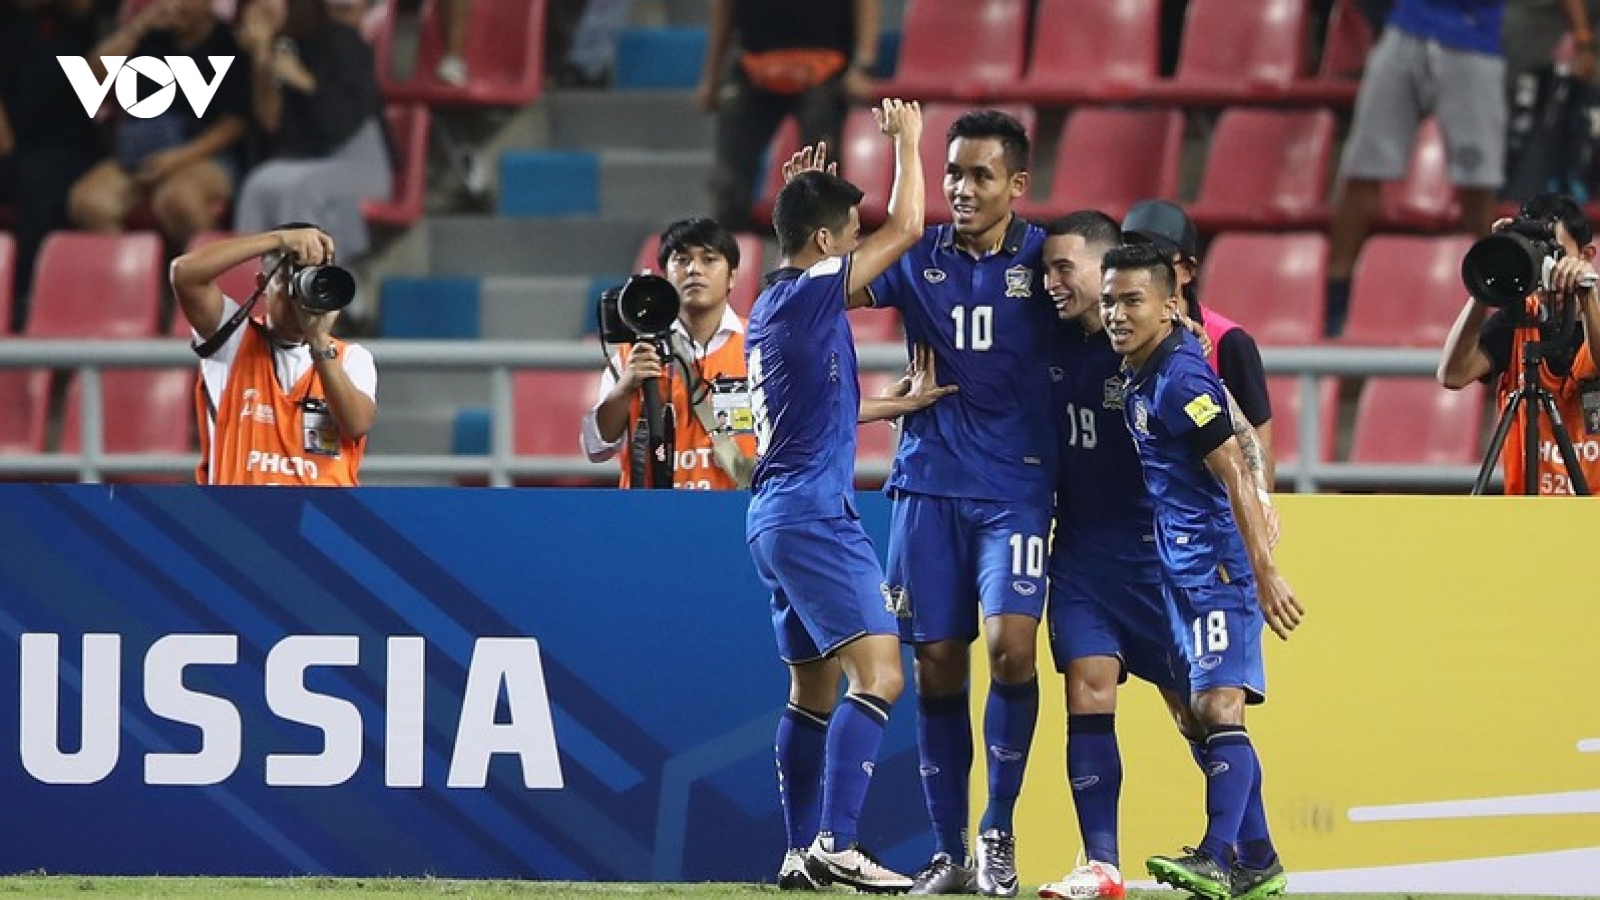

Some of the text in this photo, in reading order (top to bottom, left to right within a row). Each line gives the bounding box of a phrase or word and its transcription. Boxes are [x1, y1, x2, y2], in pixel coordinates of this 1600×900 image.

[951, 305, 994, 350] 10
[1066, 402, 1097, 449] 19
[1009, 533, 1044, 578] 10
[1192, 609, 1229, 657] 18
[20, 632, 564, 789] USSIA
